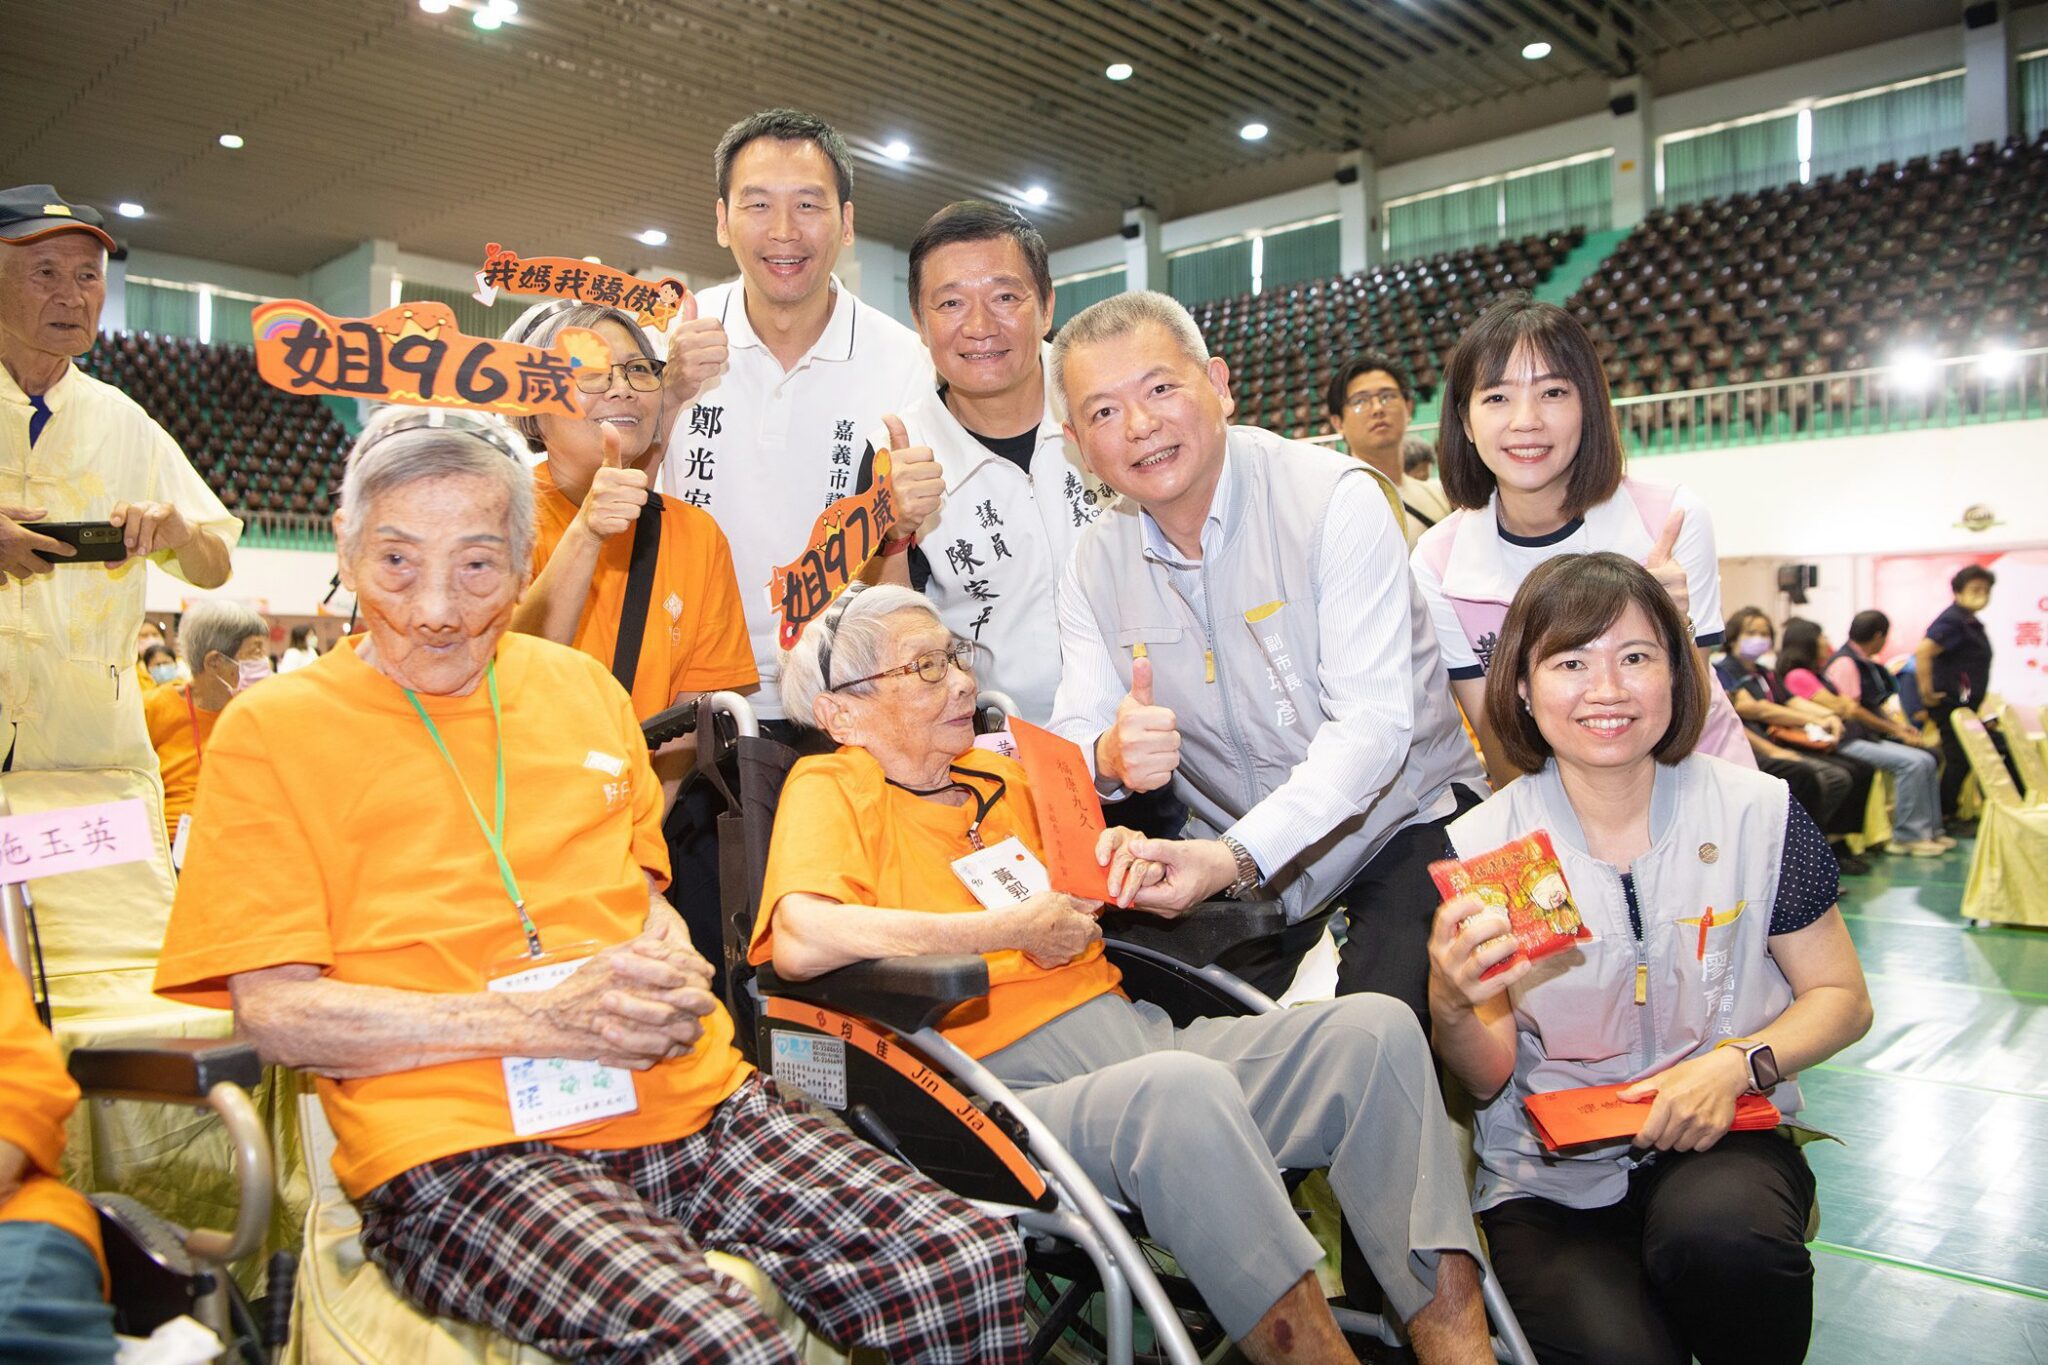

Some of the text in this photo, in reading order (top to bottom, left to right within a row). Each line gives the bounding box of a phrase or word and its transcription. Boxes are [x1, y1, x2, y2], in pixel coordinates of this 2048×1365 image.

[484, 260, 657, 317] 我媽我驕傲
[282, 316, 577, 415] 姐96歲
[782, 487, 895, 636] 姐97歲
[975, 499, 1012, 561] 議員
[945, 538, 1000, 641] 陳家平
[1263, 632, 1303, 692] 副市長
[992, 866, 1031, 902] 黃郭
[911, 1065, 939, 1094] Jin
[956, 1104, 985, 1132] Jia
